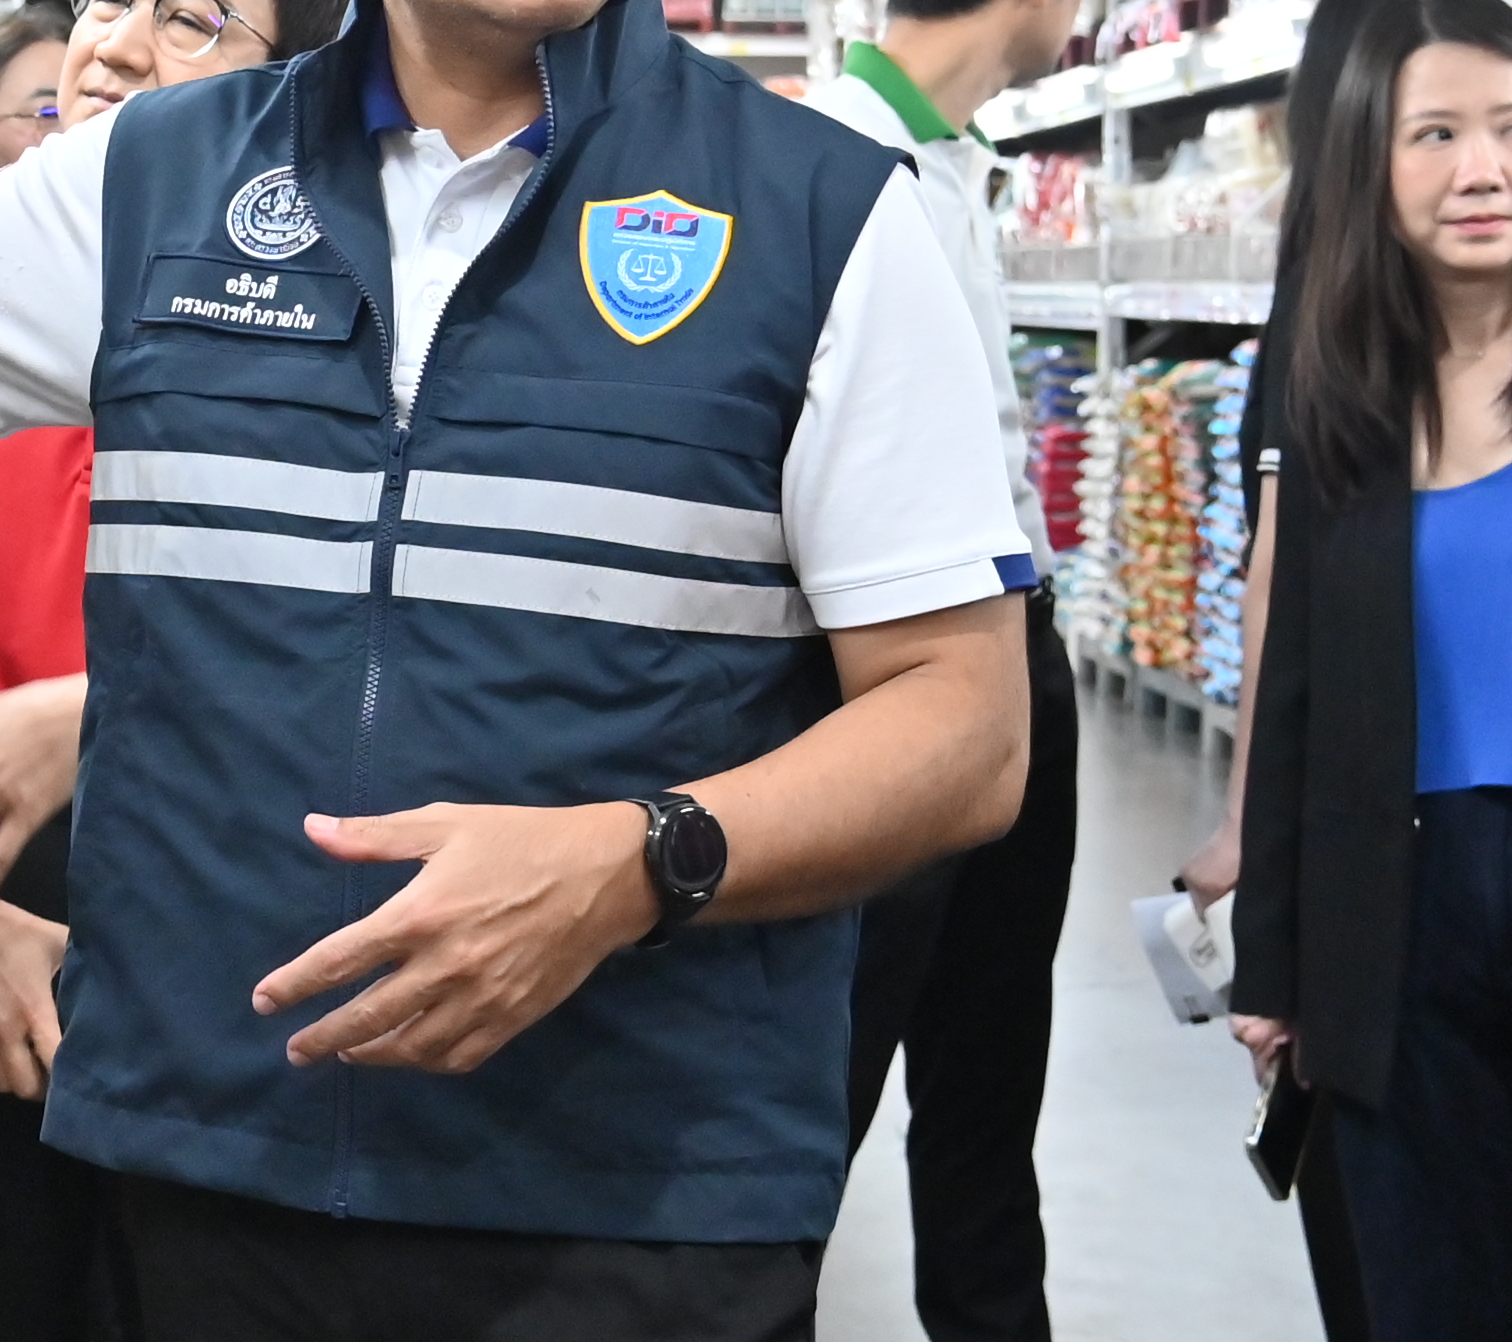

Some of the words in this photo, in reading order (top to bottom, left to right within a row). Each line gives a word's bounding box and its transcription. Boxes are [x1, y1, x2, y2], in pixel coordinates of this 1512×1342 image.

[225, 271, 280, 300] อธิบดี
[170, 295, 317, 330] กรมการค้าภายใน
